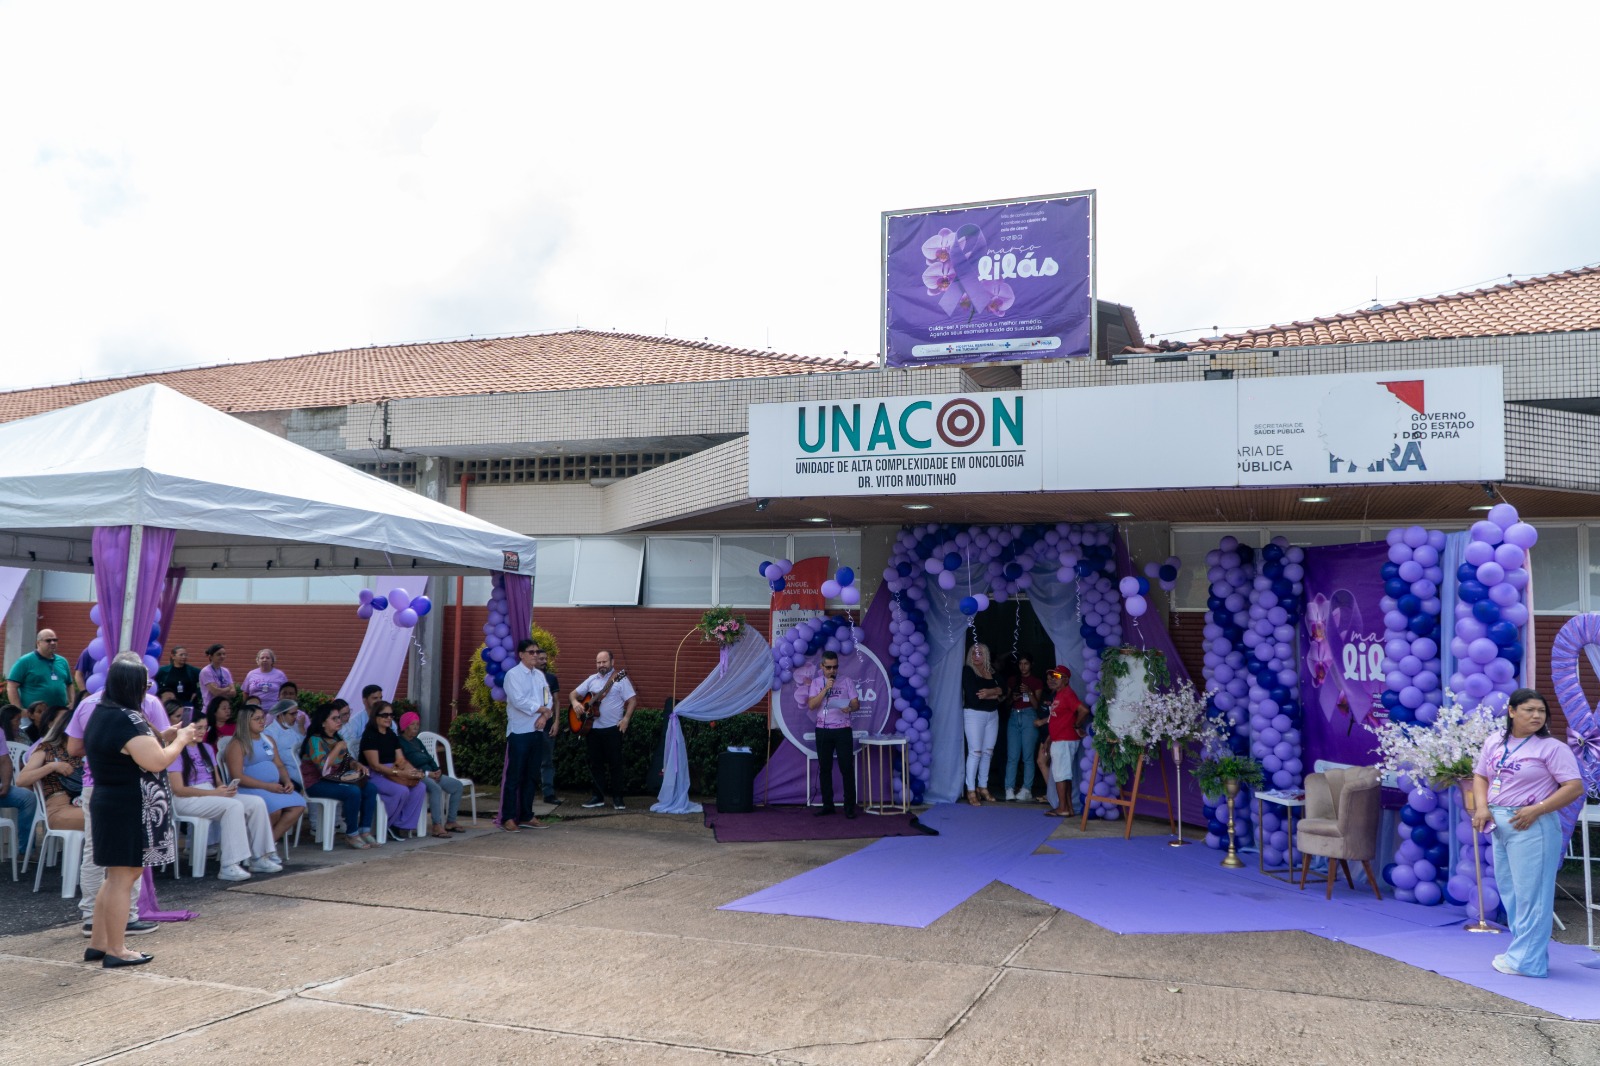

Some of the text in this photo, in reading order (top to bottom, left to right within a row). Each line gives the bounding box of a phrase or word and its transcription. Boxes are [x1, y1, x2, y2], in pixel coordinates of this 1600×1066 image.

[987, 244, 1041, 255] março
[977, 251, 1059, 281] lilás
[960, 322, 988, 330] prevenção
[1411, 412, 1466, 421] GOVERNO
[798, 396, 1023, 453] UNACON
[1411, 421, 1474, 431] DO ESTADO
[1431, 428, 1460, 439] PARÁ
[1266, 445, 1284, 456] DE
[795, 454, 1024, 474] UNIDADE DE ALTA COMPLEXIDADE EM ONCOLOGIA
[858, 473, 956, 488] DR. VITOR MOUTINHO
